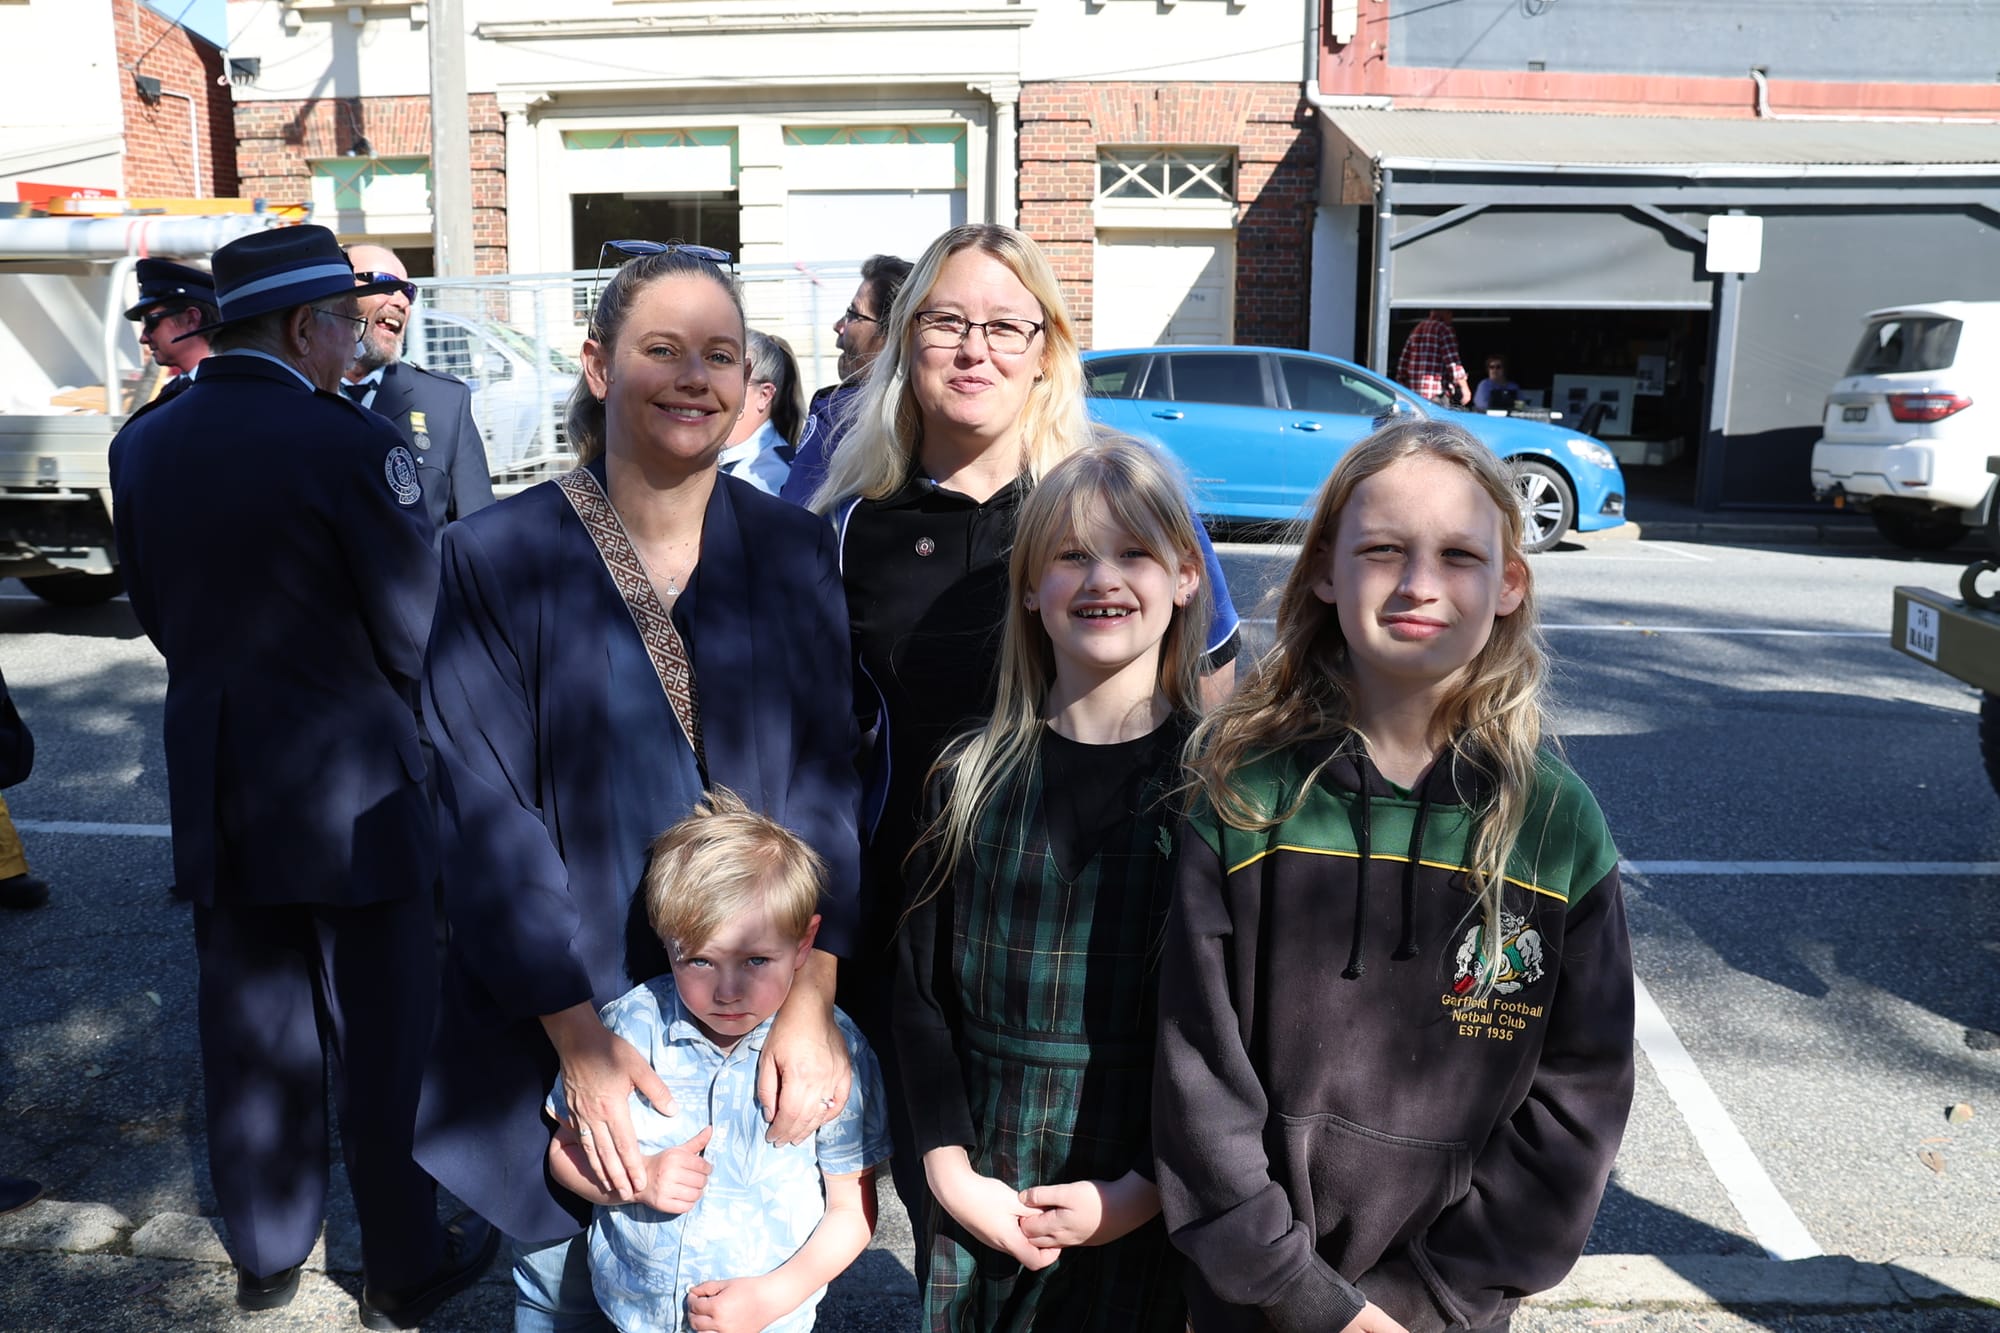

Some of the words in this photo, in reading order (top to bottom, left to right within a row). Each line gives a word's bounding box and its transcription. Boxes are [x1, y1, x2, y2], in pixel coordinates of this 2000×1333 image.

[1441, 994, 1488, 1009] Garfield
[1493, 999, 1543, 1017] Football
[1452, 1009, 1492, 1025] Netball
[1499, 1014, 1526, 1029] Club
[1459, 1025, 1482, 1037] EST
[1487, 1027, 1513, 1041] 1936
